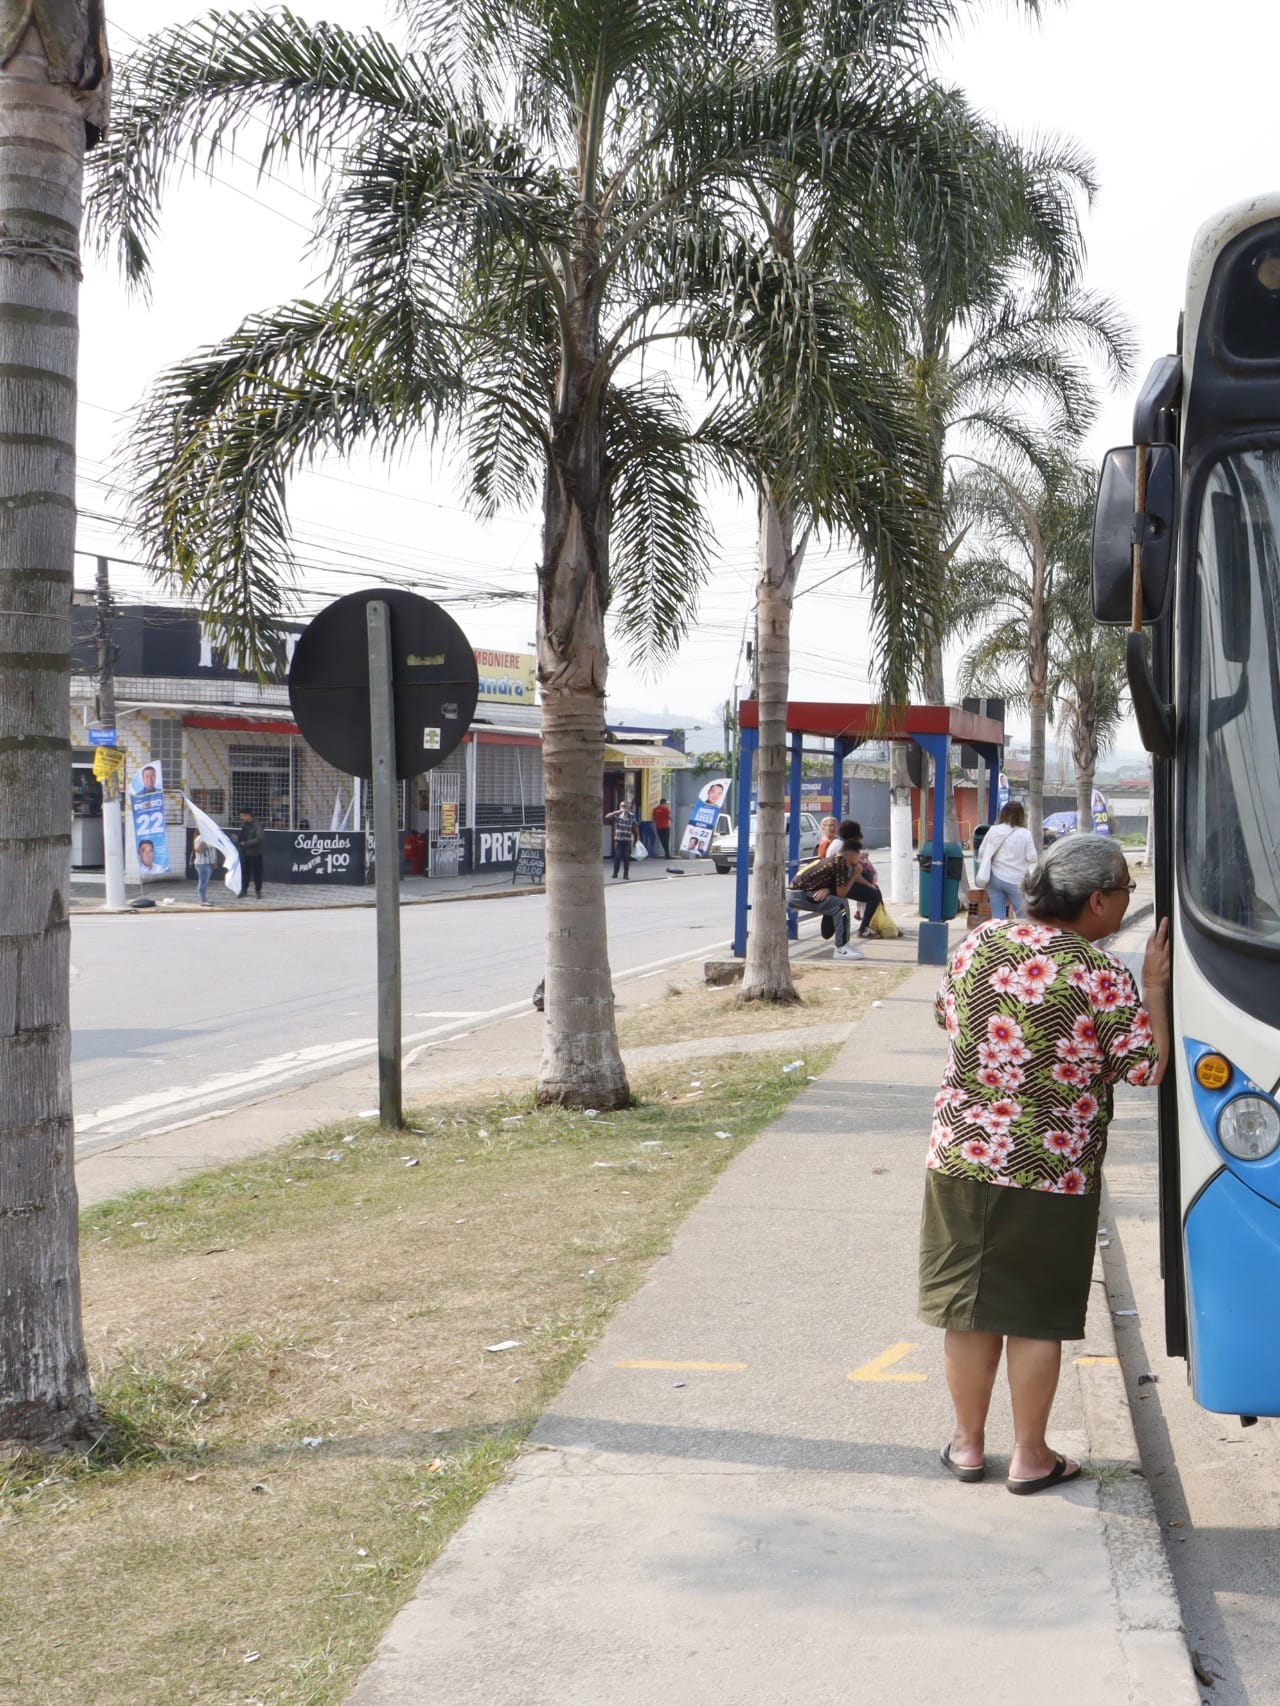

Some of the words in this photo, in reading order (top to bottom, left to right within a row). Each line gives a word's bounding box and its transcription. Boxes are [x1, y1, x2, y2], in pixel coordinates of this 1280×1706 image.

[136, 812, 164, 836] 22
[1094, 812, 1108, 823] 20
[294, 833, 351, 855] Salgados
